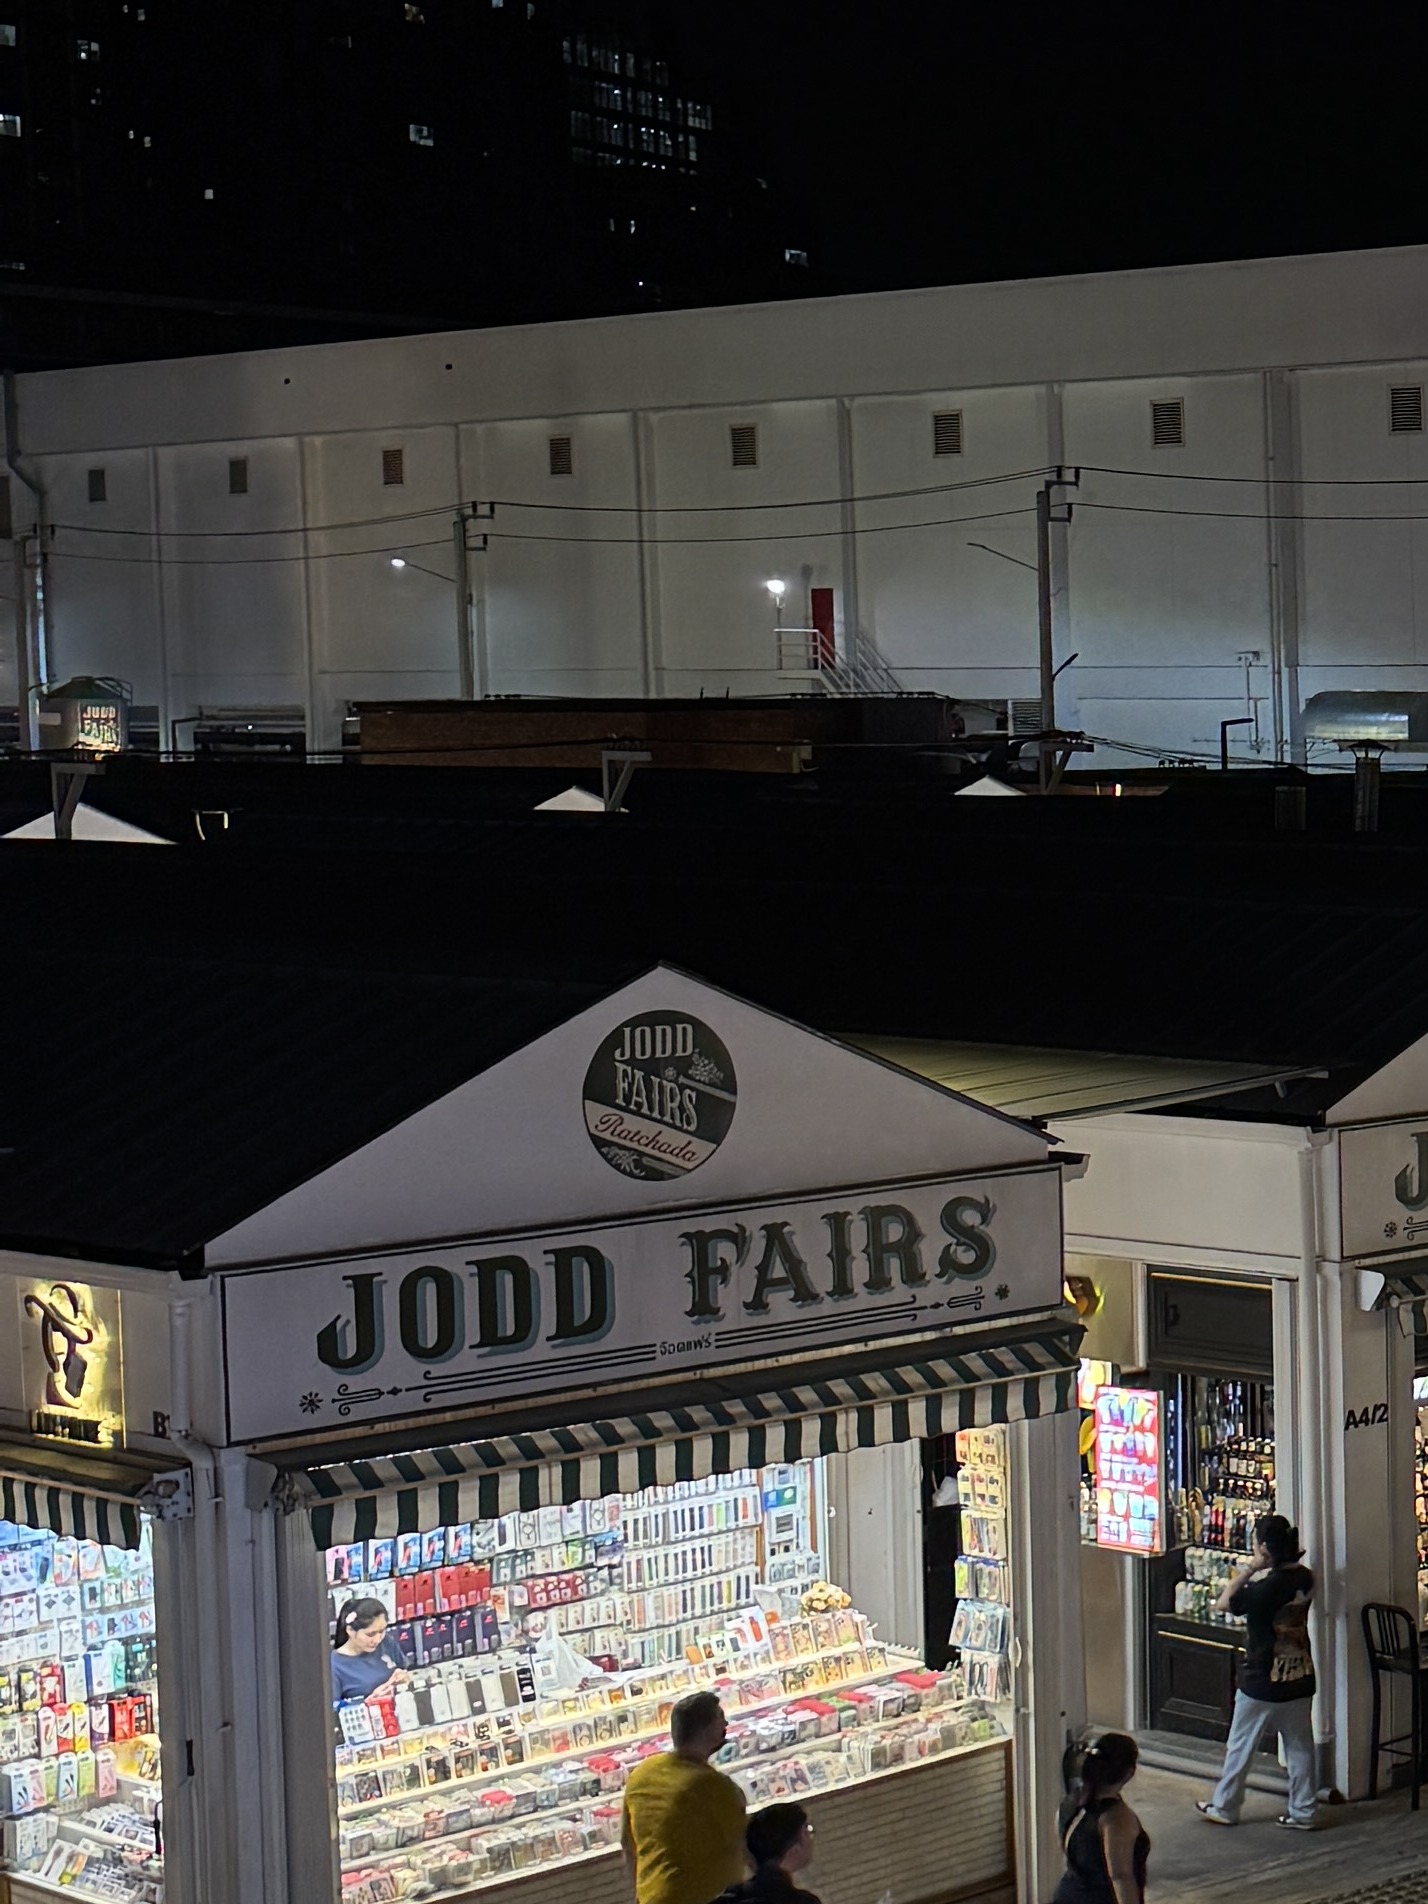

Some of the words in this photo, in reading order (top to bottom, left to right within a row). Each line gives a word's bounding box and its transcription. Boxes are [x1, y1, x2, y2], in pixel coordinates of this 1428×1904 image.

[614, 1023, 694, 1061] JODD
[614, 1061, 698, 1132] FAIRS
[595, 1113, 699, 1163] Ratchada
[317, 1244, 616, 1376] JODD
[678, 1196, 998, 1324] FAIRS
[1344, 1403, 1389, 1431] A4/2
